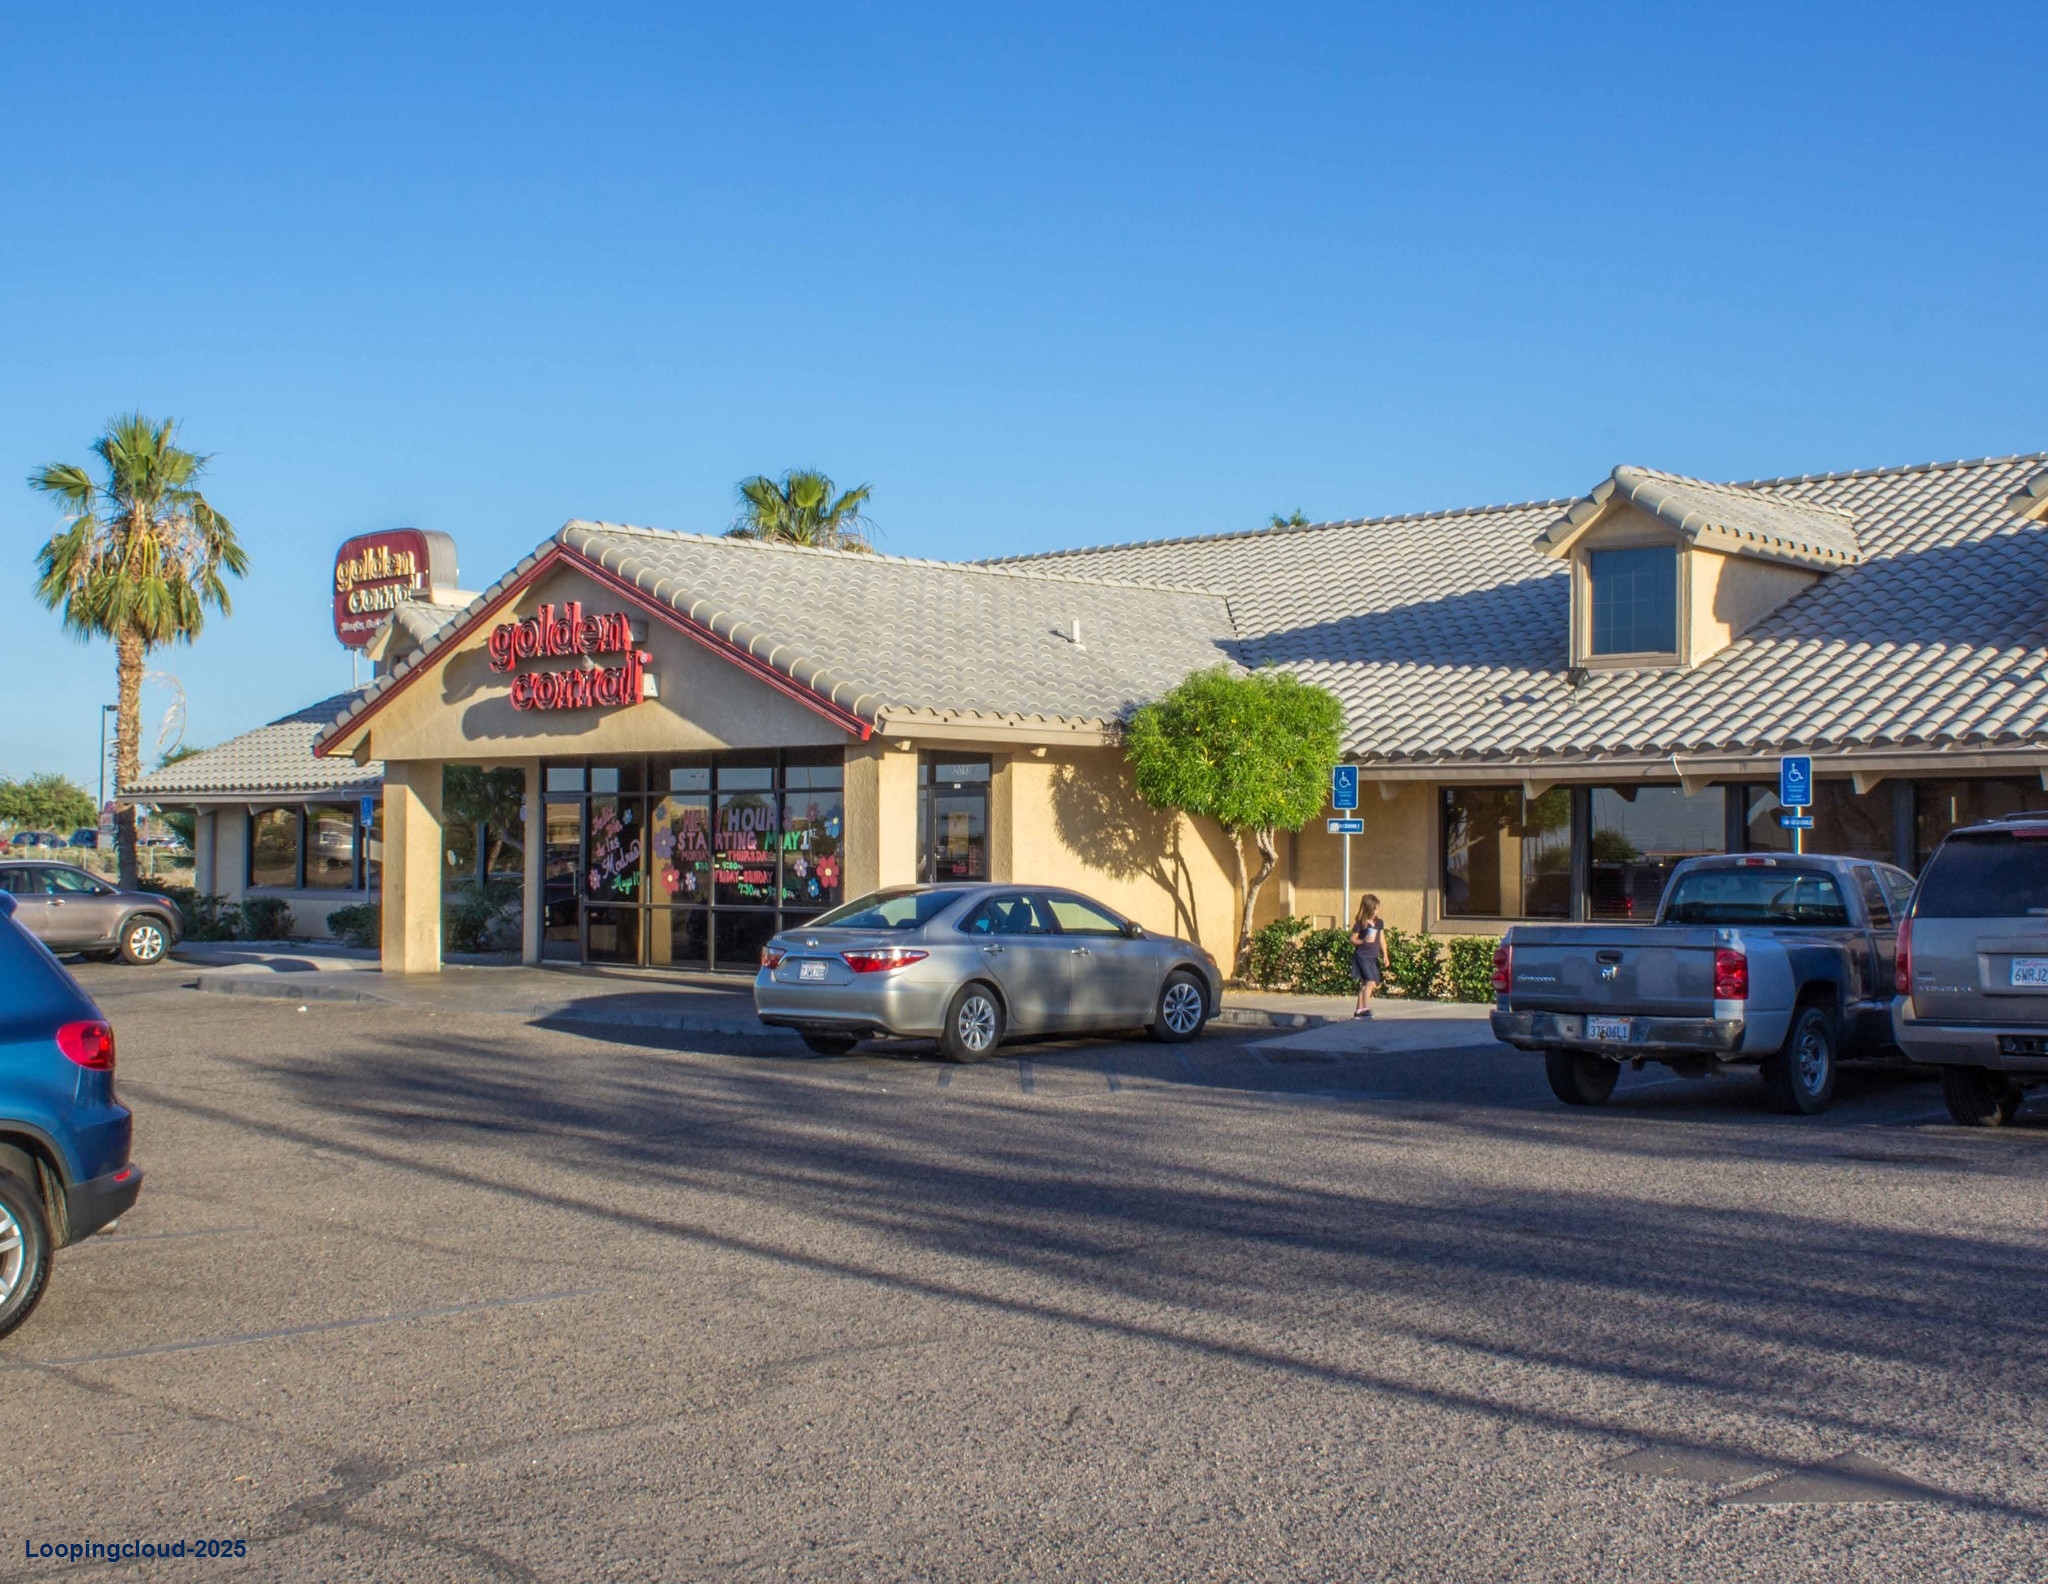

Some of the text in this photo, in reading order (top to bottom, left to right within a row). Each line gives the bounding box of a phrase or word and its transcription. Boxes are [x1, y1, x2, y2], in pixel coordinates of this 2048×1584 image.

[336, 545, 415, 592] golden
[489, 602, 632, 672] golden
[511, 651, 644, 711] corral
[677, 831, 758, 850] STARTING
[765, 830, 801, 850] MAY
